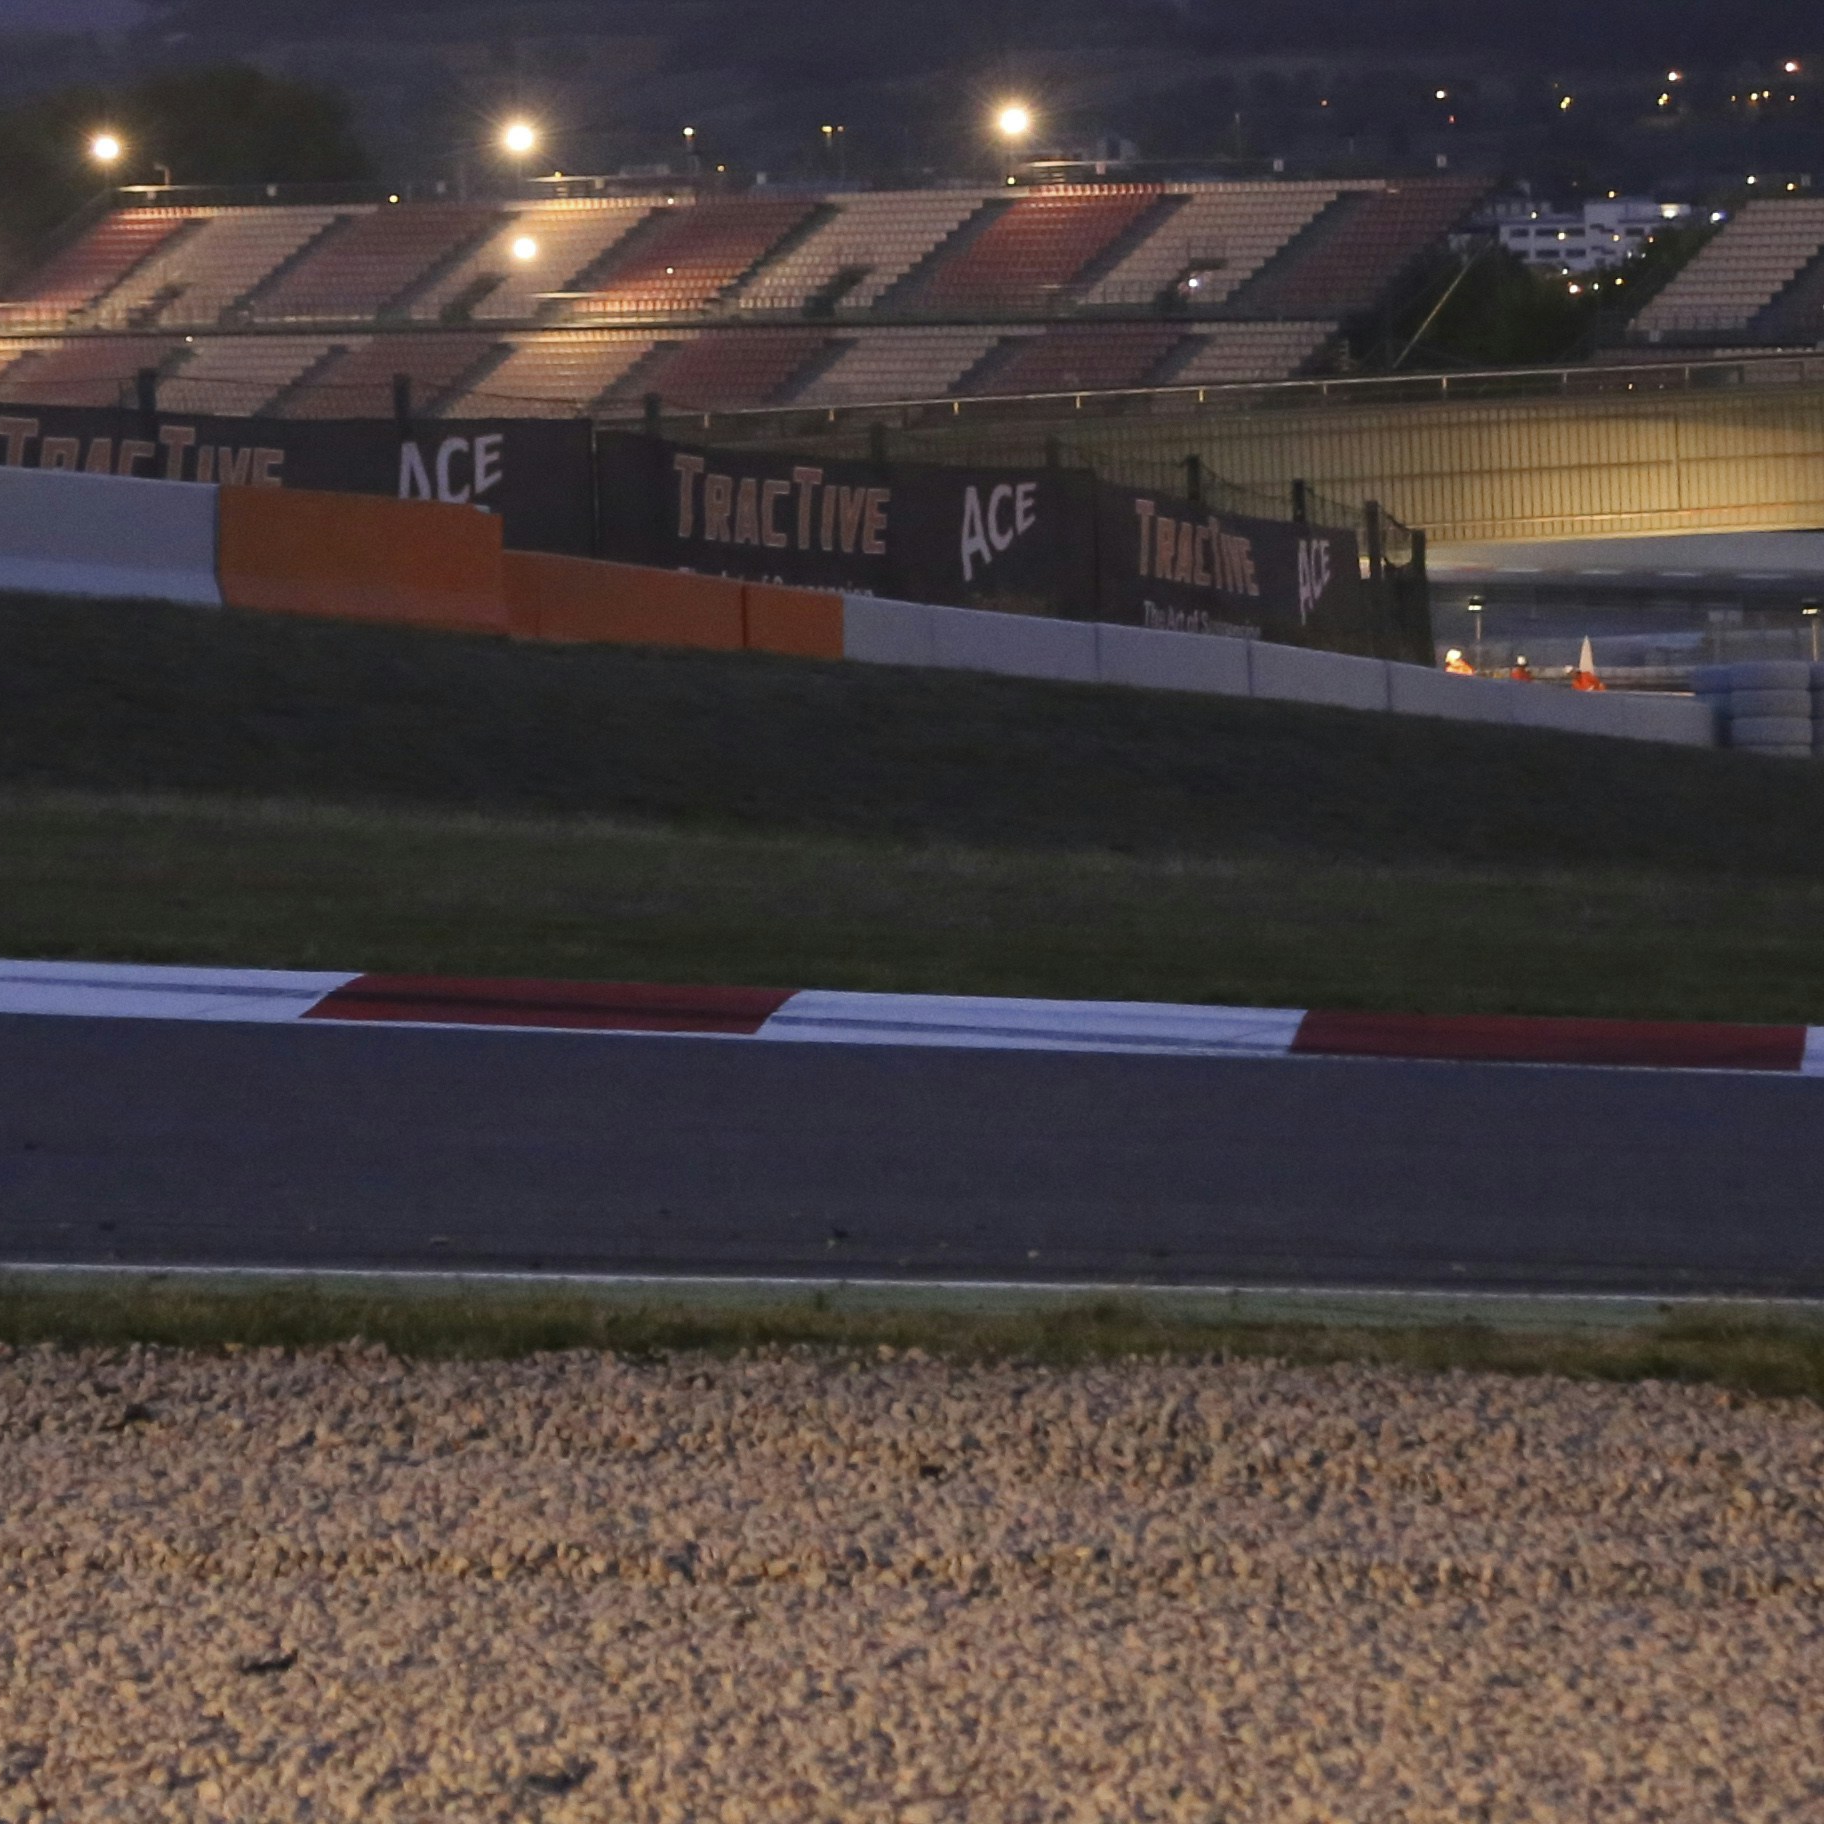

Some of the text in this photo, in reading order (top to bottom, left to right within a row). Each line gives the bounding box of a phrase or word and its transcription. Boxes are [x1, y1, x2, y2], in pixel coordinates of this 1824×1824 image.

[398, 433, 504, 504] ACE
[960, 482, 1037, 582] ACE
[1296, 538, 1331, 626] ACE
